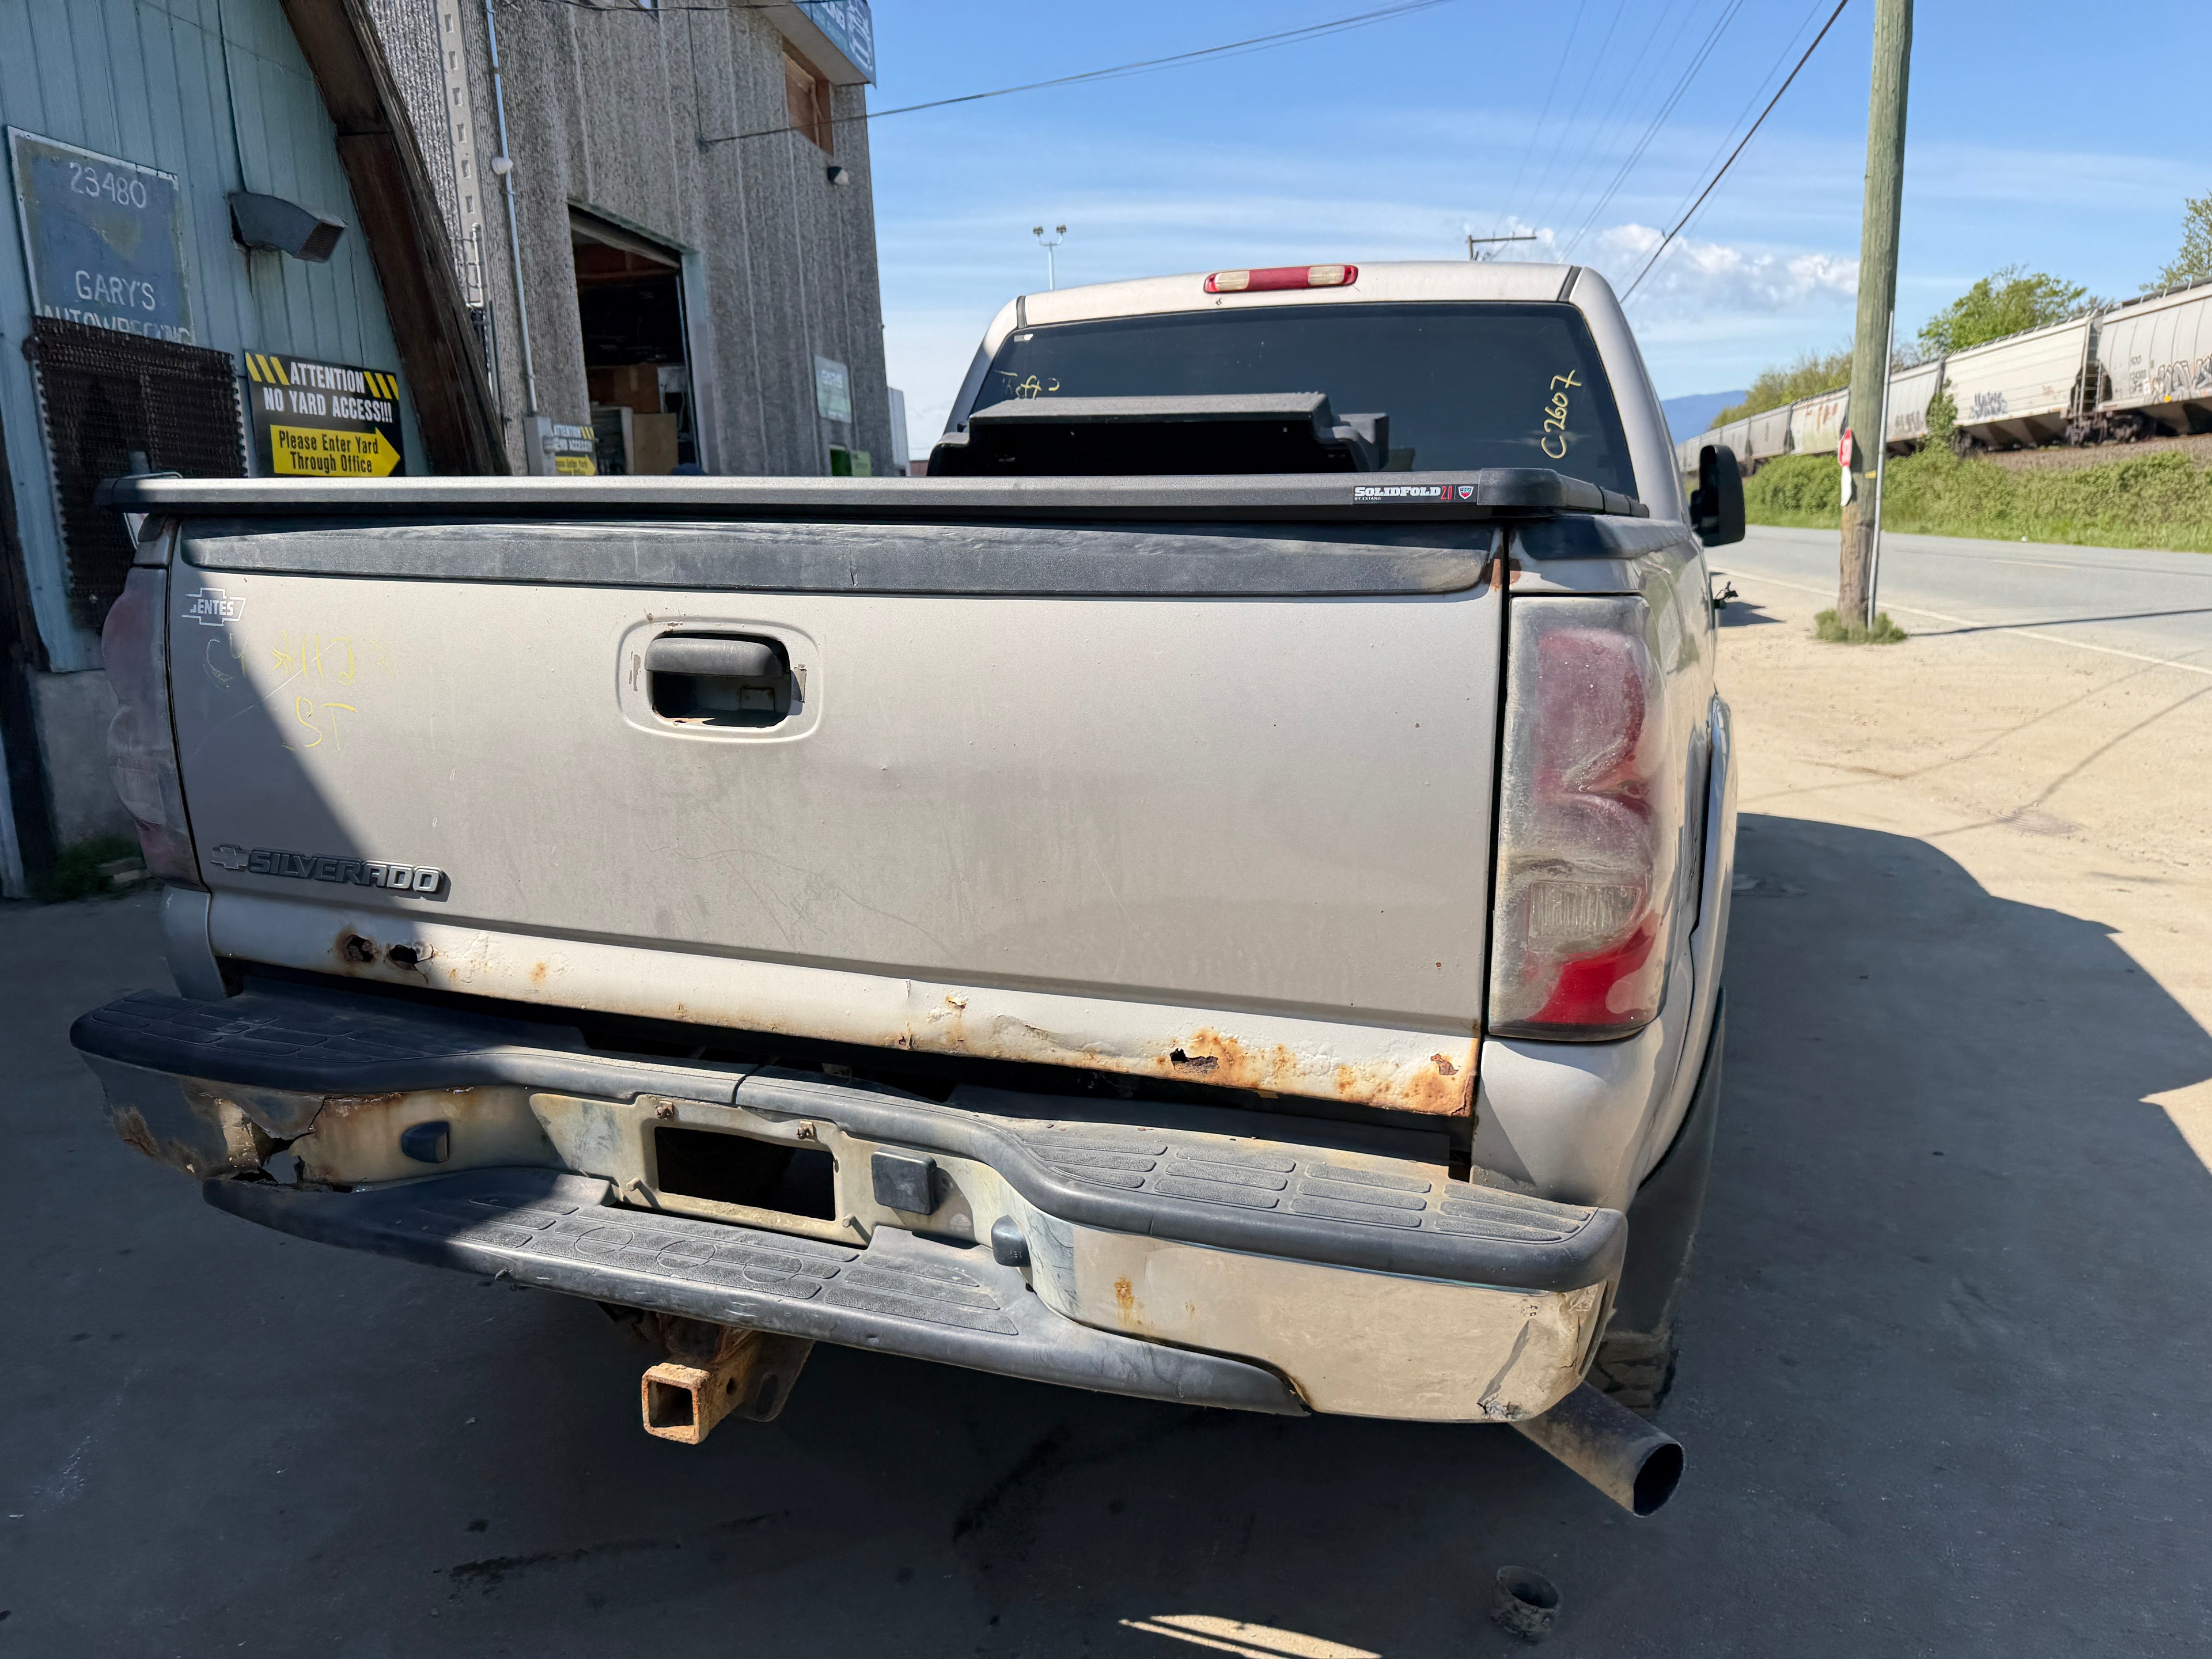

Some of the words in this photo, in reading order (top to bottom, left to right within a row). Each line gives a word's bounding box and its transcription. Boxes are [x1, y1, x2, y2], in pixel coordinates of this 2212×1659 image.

[70, 161, 146, 209] 23480
[75, 270, 156, 311] GARY'S
[290, 361, 365, 394] ATTENTION
[263, 387, 284, 411] NO
[289, 391, 325, 415] YARD
[332, 396, 393, 423] ACCESS!!!
[1541, 369, 1582, 459] C2607
[279, 430, 317, 450] Please
[323, 434, 351, 452] Enter
[355, 437, 378, 454] Yard
[290, 452, 336, 474] Through
[341, 455, 372, 472] Office
[248, 849, 442, 893] SILVERADO
